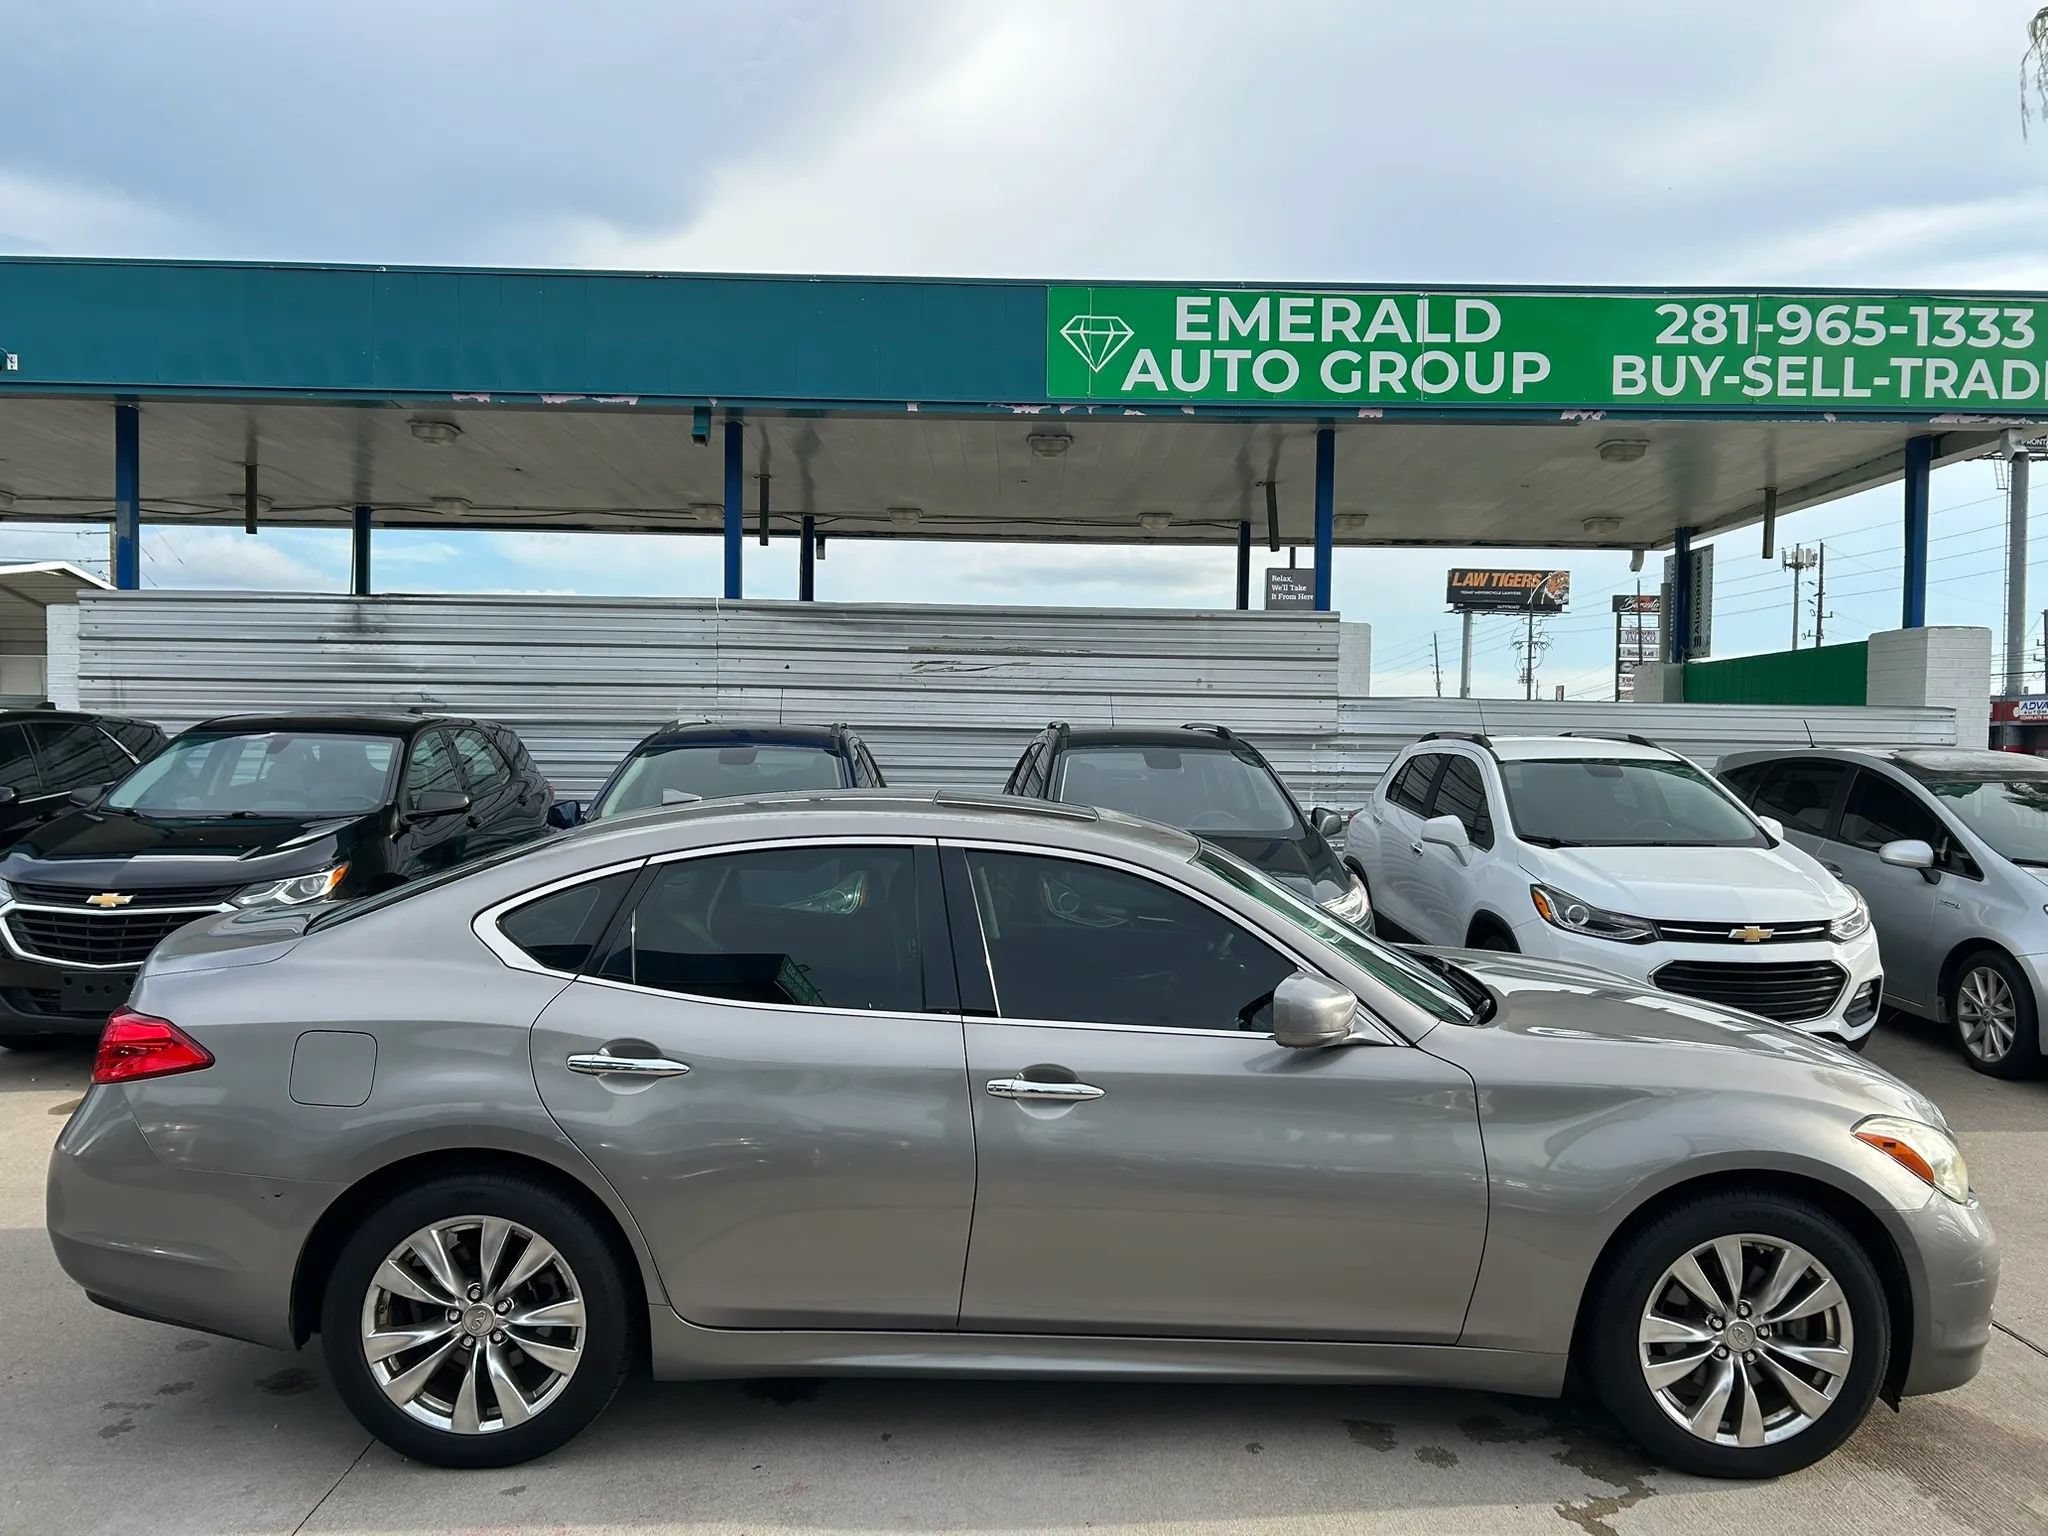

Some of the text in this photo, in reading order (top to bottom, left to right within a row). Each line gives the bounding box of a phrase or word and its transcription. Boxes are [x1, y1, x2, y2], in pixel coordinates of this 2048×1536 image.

[1175, 296, 1502, 344] EMERALD
[1654, 303, 2036, 349] 281-965-1333
[1119, 348, 1552, 394] AUTO GROUP
[1611, 354, 2048, 400] BUY-SELL-TRAD
[1271, 574, 1293, 583] Relax,
[1452, 572, 1543, 588] LAW TIGERS
